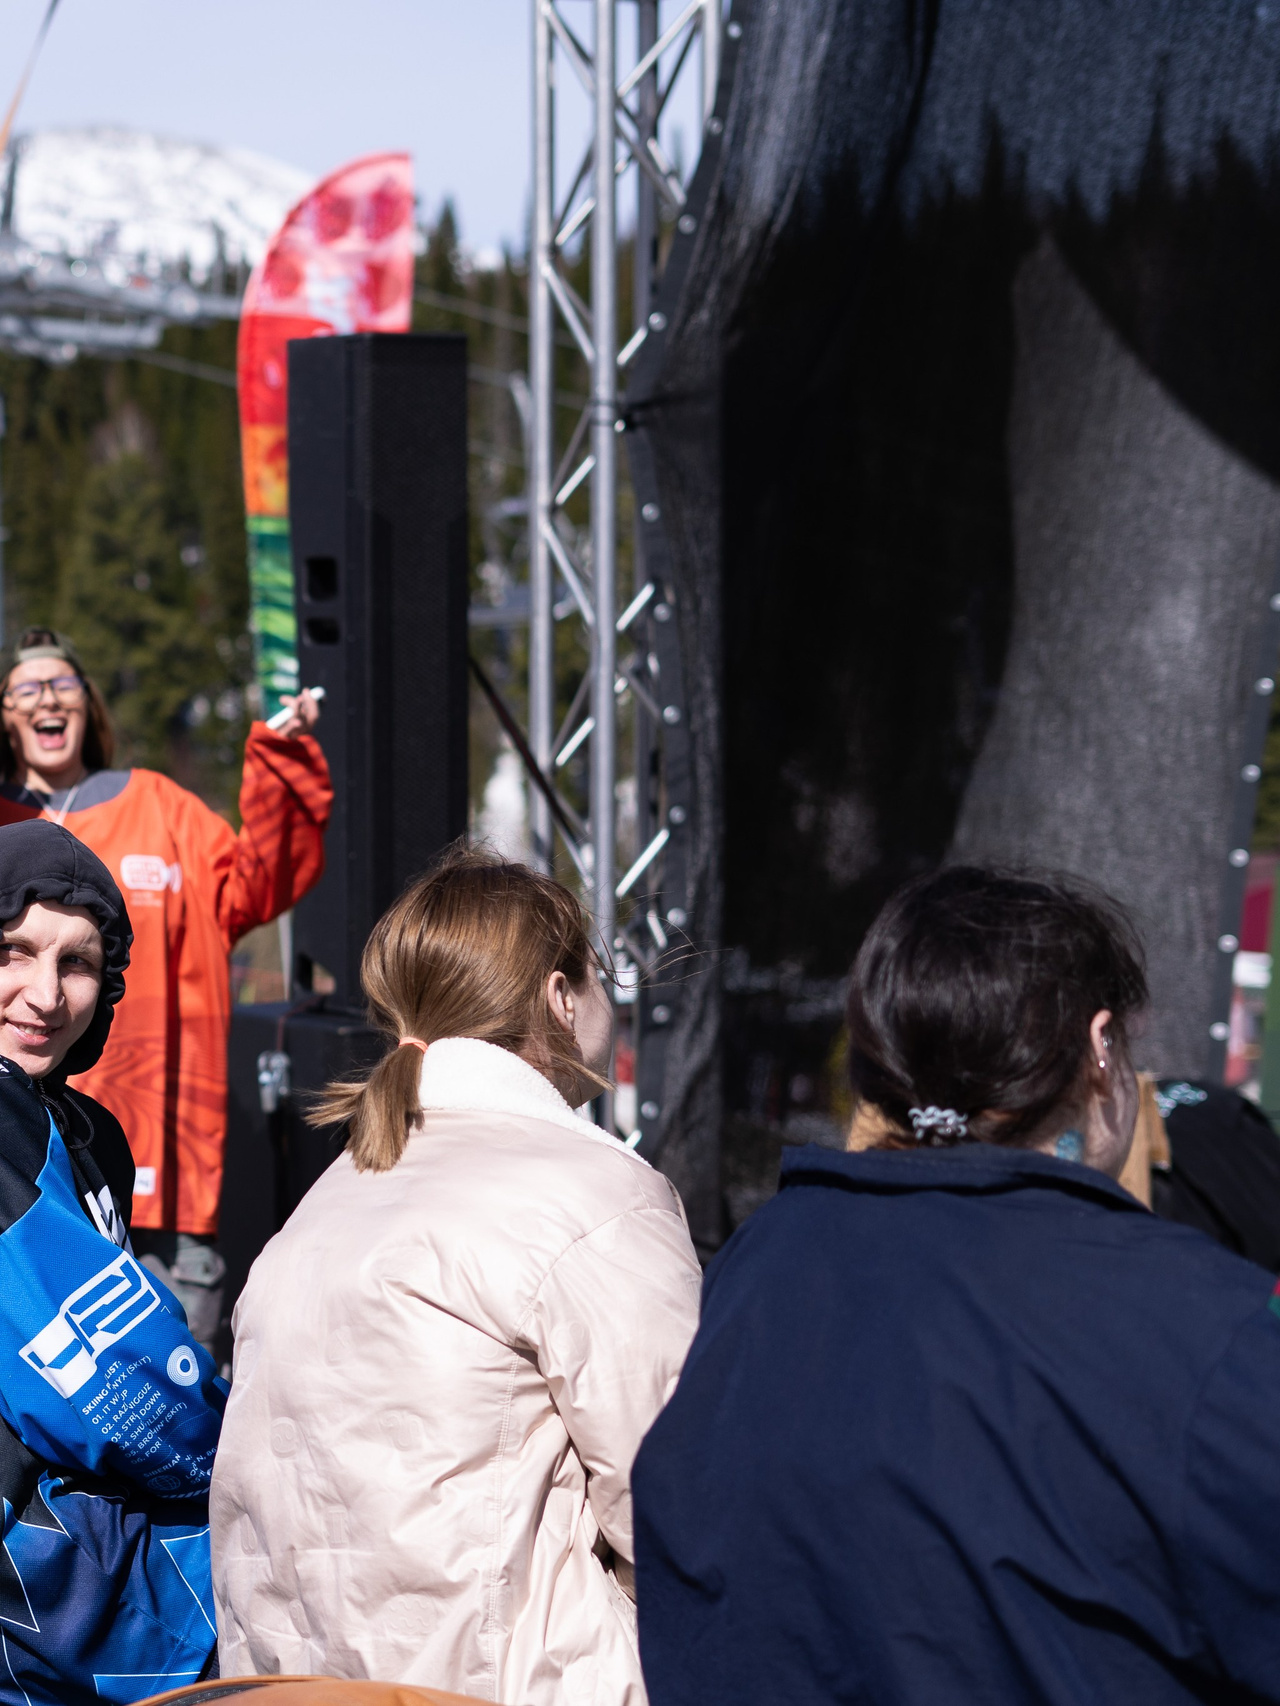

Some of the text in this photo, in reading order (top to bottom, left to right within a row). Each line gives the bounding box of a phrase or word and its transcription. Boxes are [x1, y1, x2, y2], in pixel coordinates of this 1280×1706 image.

[92, 1414, 104, 1424] 01.
[102, 1404, 111, 1414] IT
[112, 1372, 127, 1390] NYX
[126, 1355, 152, 1375] (SKIT)
[82, 1389, 109, 1415] SKIING
[139, 1390, 161, 1416] DOWN
[165, 1402, 188, 1423] (SKIT)
[101, 1423, 115, 1434] 02.
[111, 1432, 123, 1443] 03.
